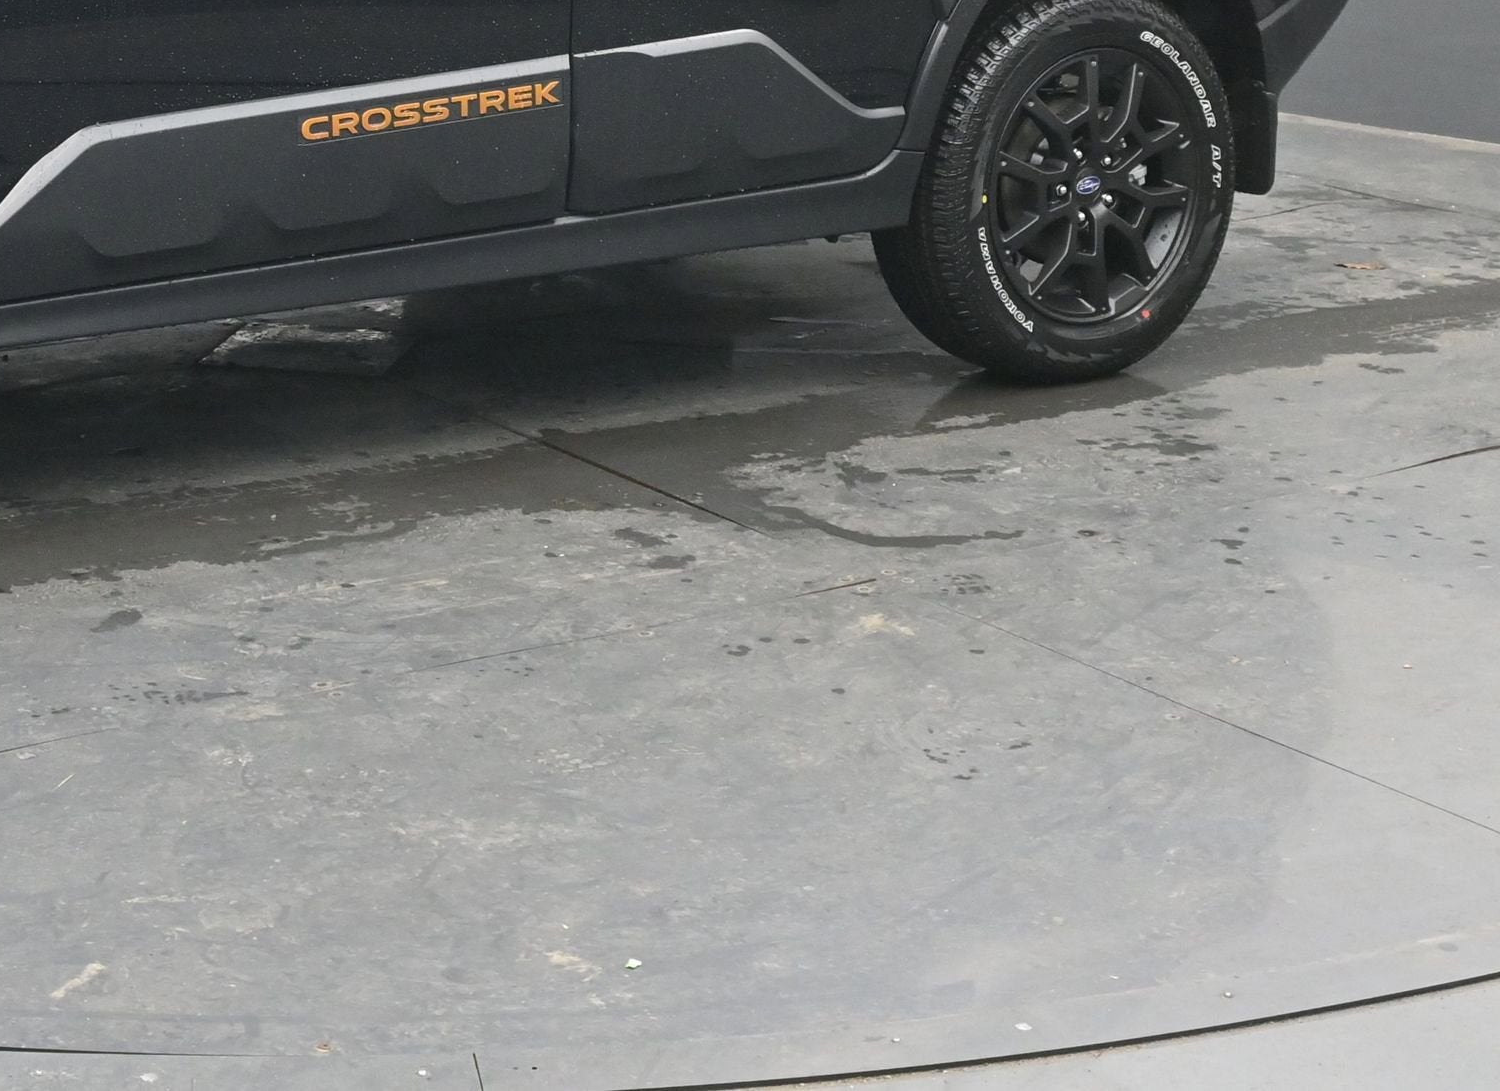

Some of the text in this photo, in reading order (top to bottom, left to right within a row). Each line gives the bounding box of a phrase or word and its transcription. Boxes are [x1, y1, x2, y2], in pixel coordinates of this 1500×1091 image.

[301, 80, 561, 141] CROSSTREK
[1140, 31, 1222, 189] GEOLANDAR A/T
[978, 226, 1034, 333] YOKOHAMA
